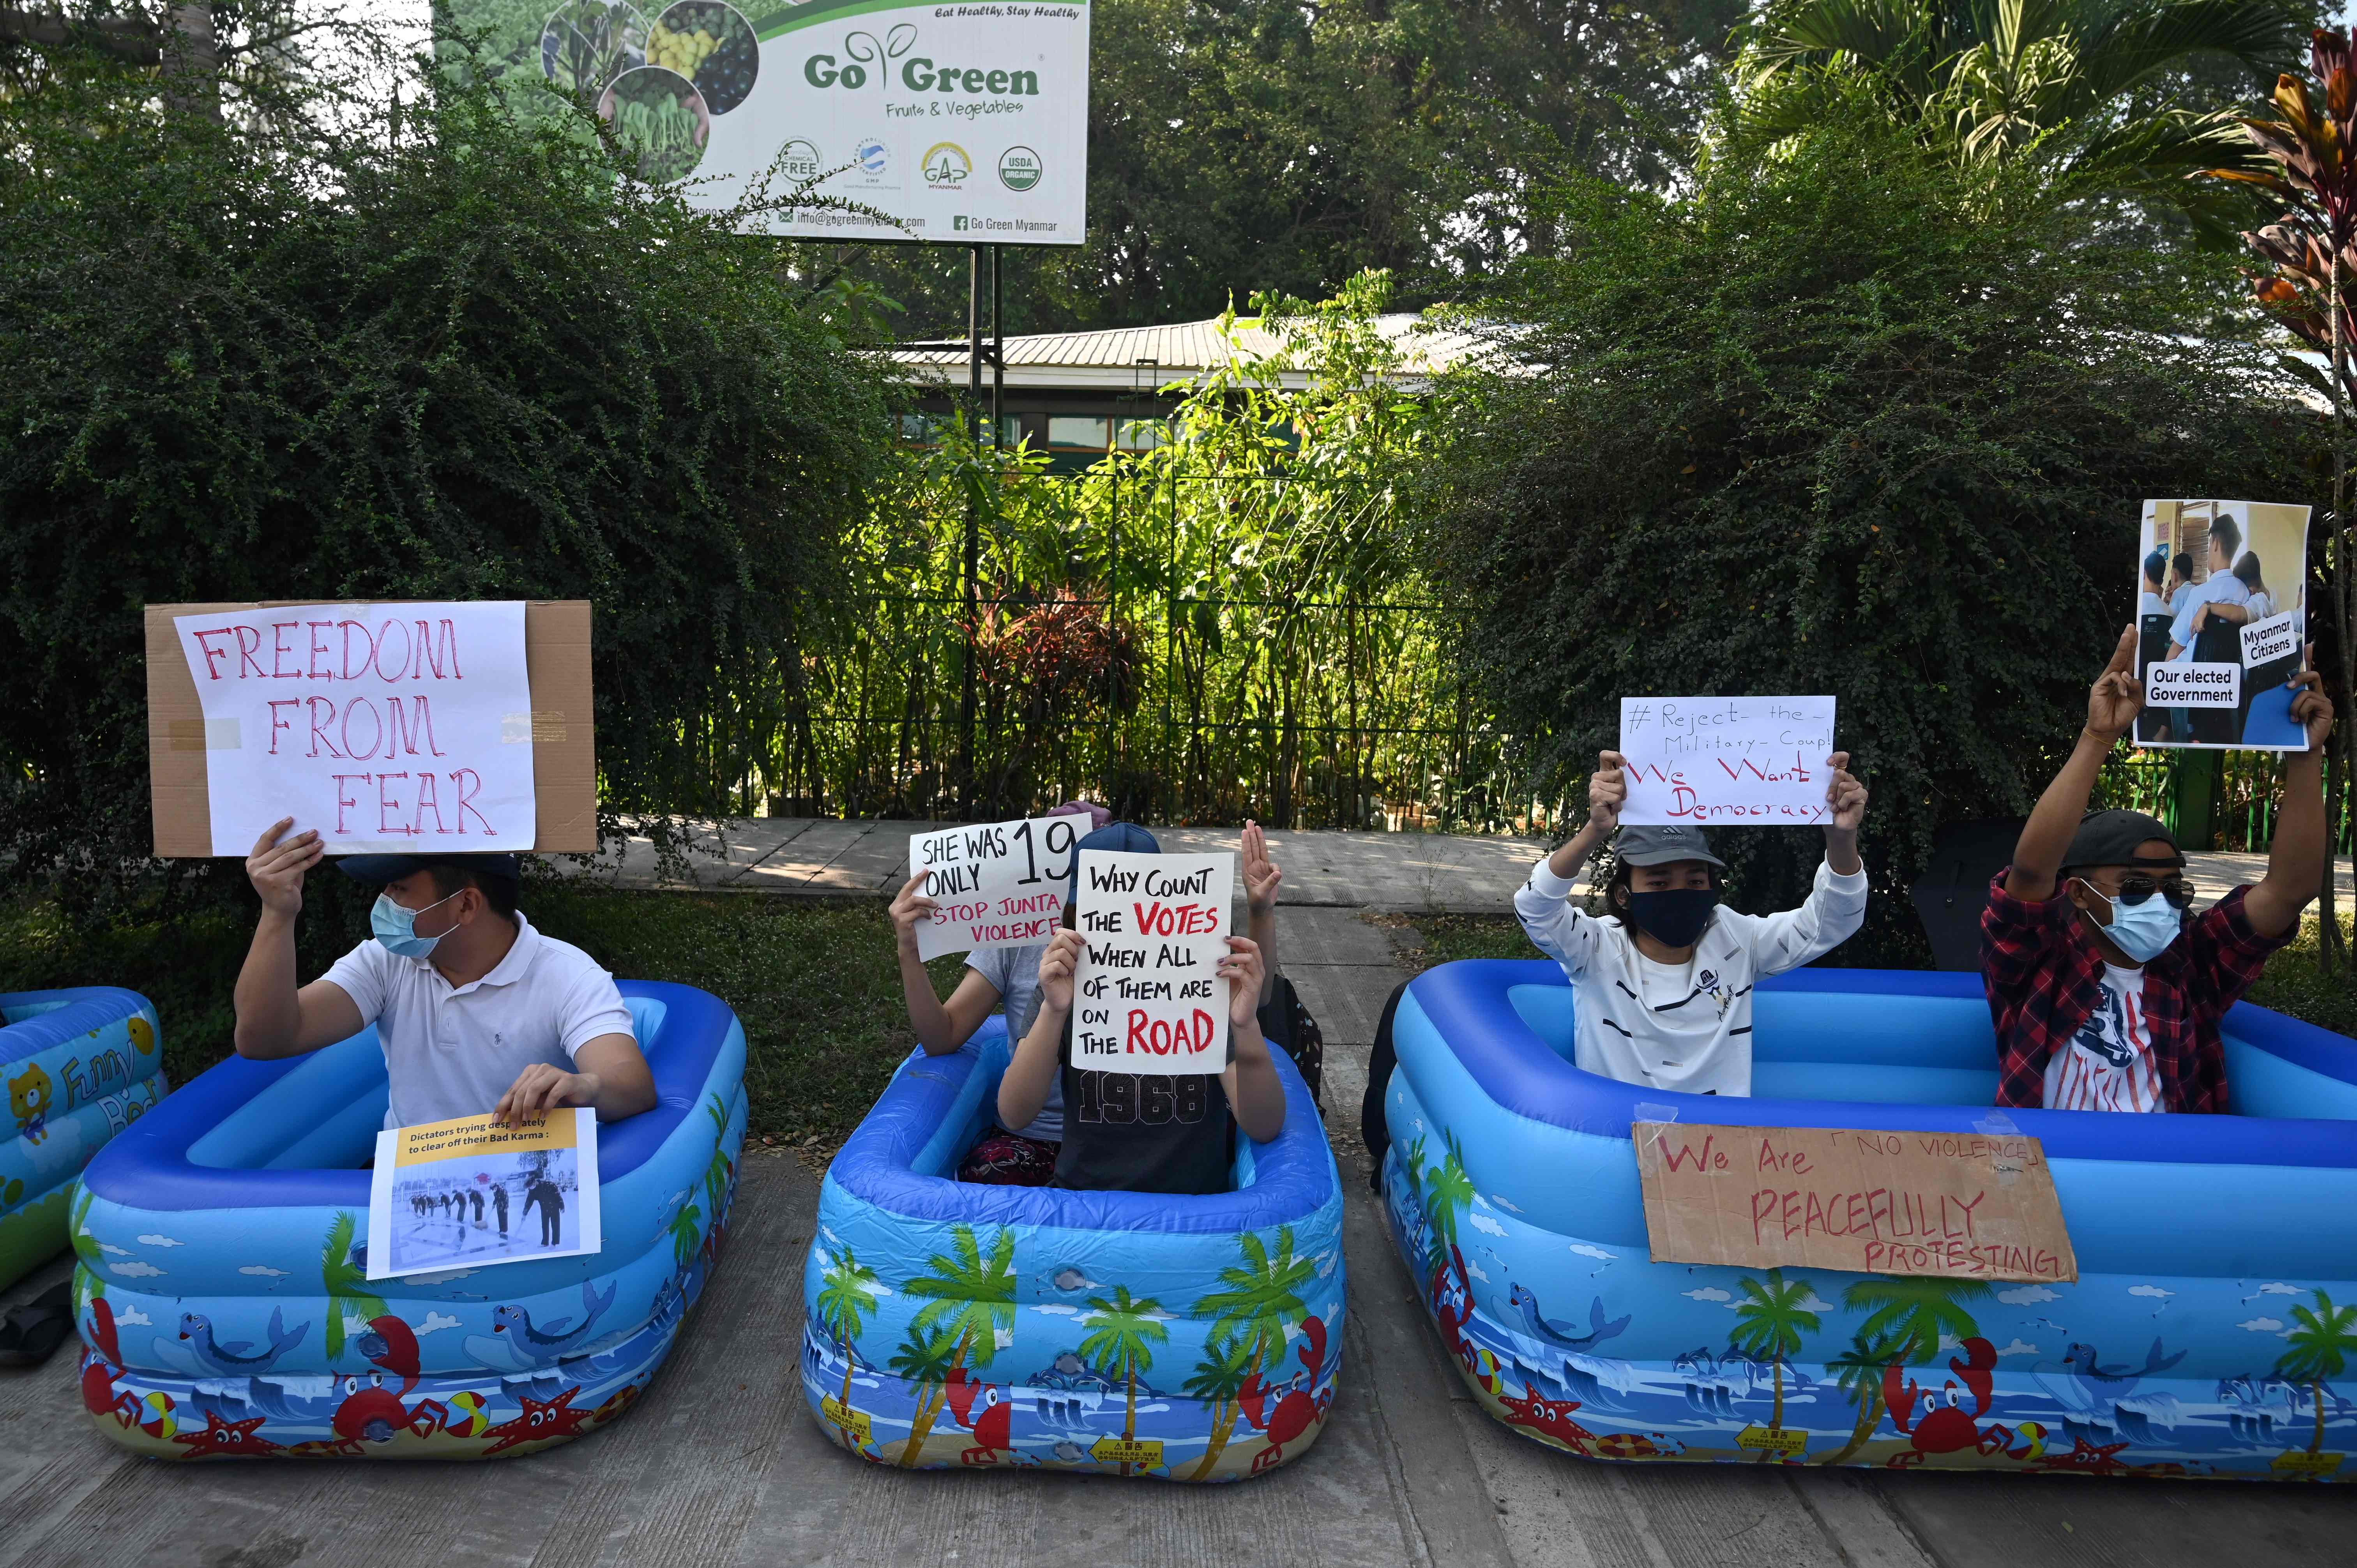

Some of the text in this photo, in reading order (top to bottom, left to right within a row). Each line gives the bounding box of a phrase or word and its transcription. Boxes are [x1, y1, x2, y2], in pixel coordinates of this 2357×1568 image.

[935, 6, 1079, 20] Eat Healthy, Stay Healthy
[804, 55, 1039, 95] Go Green
[886, 100, 1023, 120] Fruits & Vegetables
[781, 162, 816, 174] FREE
[924, 157, 968, 184] GAP
[1005, 170, 1035, 179] ORGANIC
[1009, 157, 1032, 167] USDA
[798, 212, 925, 227] info@gogreenmyanmr.com
[972, 218, 1057, 232] Go Green Myanmar
[2244, 619, 2291, 646] Myanmar
[193, 618, 464, 683] FREEDOM
[2251, 638, 2290, 661] Citizens
[2154, 669, 2231, 684] Our elected
[2150, 687, 2233, 702] Government
[267, 695, 447, 761] FROM
[1780, 729, 1830, 750] Coup!
[1627, 750, 1810, 785] We Want
[332, 768, 497, 837] FEAR
[1666, 786, 1827, 824] Democracy
[922, 821, 1076, 886] SHE WAS 19
[925, 863, 981, 897] ONLY
[1090, 863, 1215, 897] WHY COUNT
[933, 893, 1061, 926] STOP JUNTA
[1082, 901, 1218, 937] THE VOTES
[971, 916, 1062, 943] VIOLENCE
[1088, 942, 1197, 969] WHEN ALL
[1083, 975, 1212, 1001] OF THEM ARE
[1082, 1009, 1109, 1025] ON
[1078, 1008, 1215, 1056] THE ROAD
[60, 1038, 135, 1110] Funny
[1079, 1070, 1207, 1125] 1968
[410, 1118, 546, 1142] Dictators trying despately
[421, 1142, 445, 1152] clear
[448, 1138, 462, 1148] off
[463, 1135, 488, 1145] their
[490, 1132, 509, 1142] Bad
[511, 1131, 543, 1141] Karma
[1658, 1133, 1814, 1175] We Are
[1750, 1188, 1985, 1245] PEACEFULLY
[1865, 1241, 2058, 1278] PROTESTING
